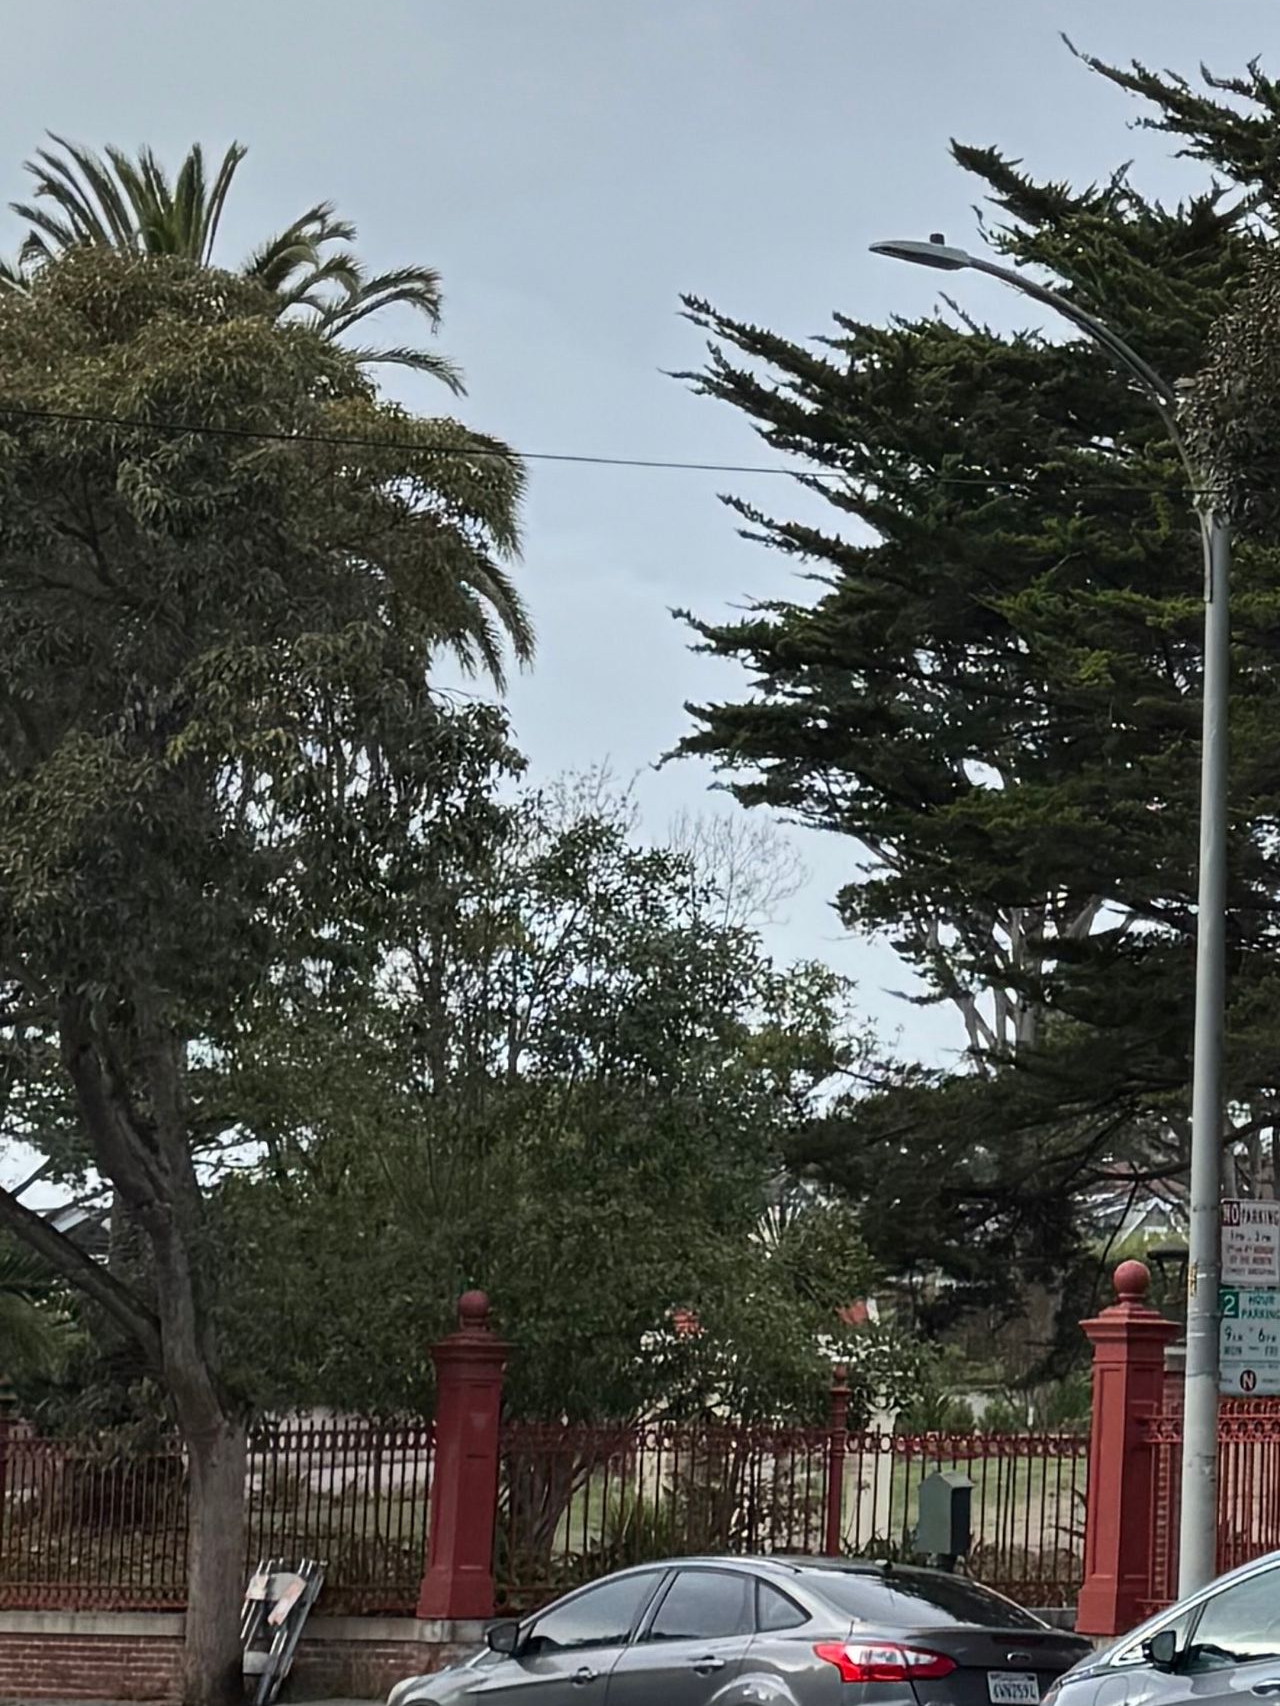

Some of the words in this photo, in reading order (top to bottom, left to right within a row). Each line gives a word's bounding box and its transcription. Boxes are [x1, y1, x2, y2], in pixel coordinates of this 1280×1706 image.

[1222, 1203, 1239, 1224] NO
[1241, 1207, 1279, 1226] PARKING
[1223, 1294, 1236, 1315] 2
[1247, 1295, 1275, 1306] HOUR
[1240, 1308, 1280, 1320] PARKING
